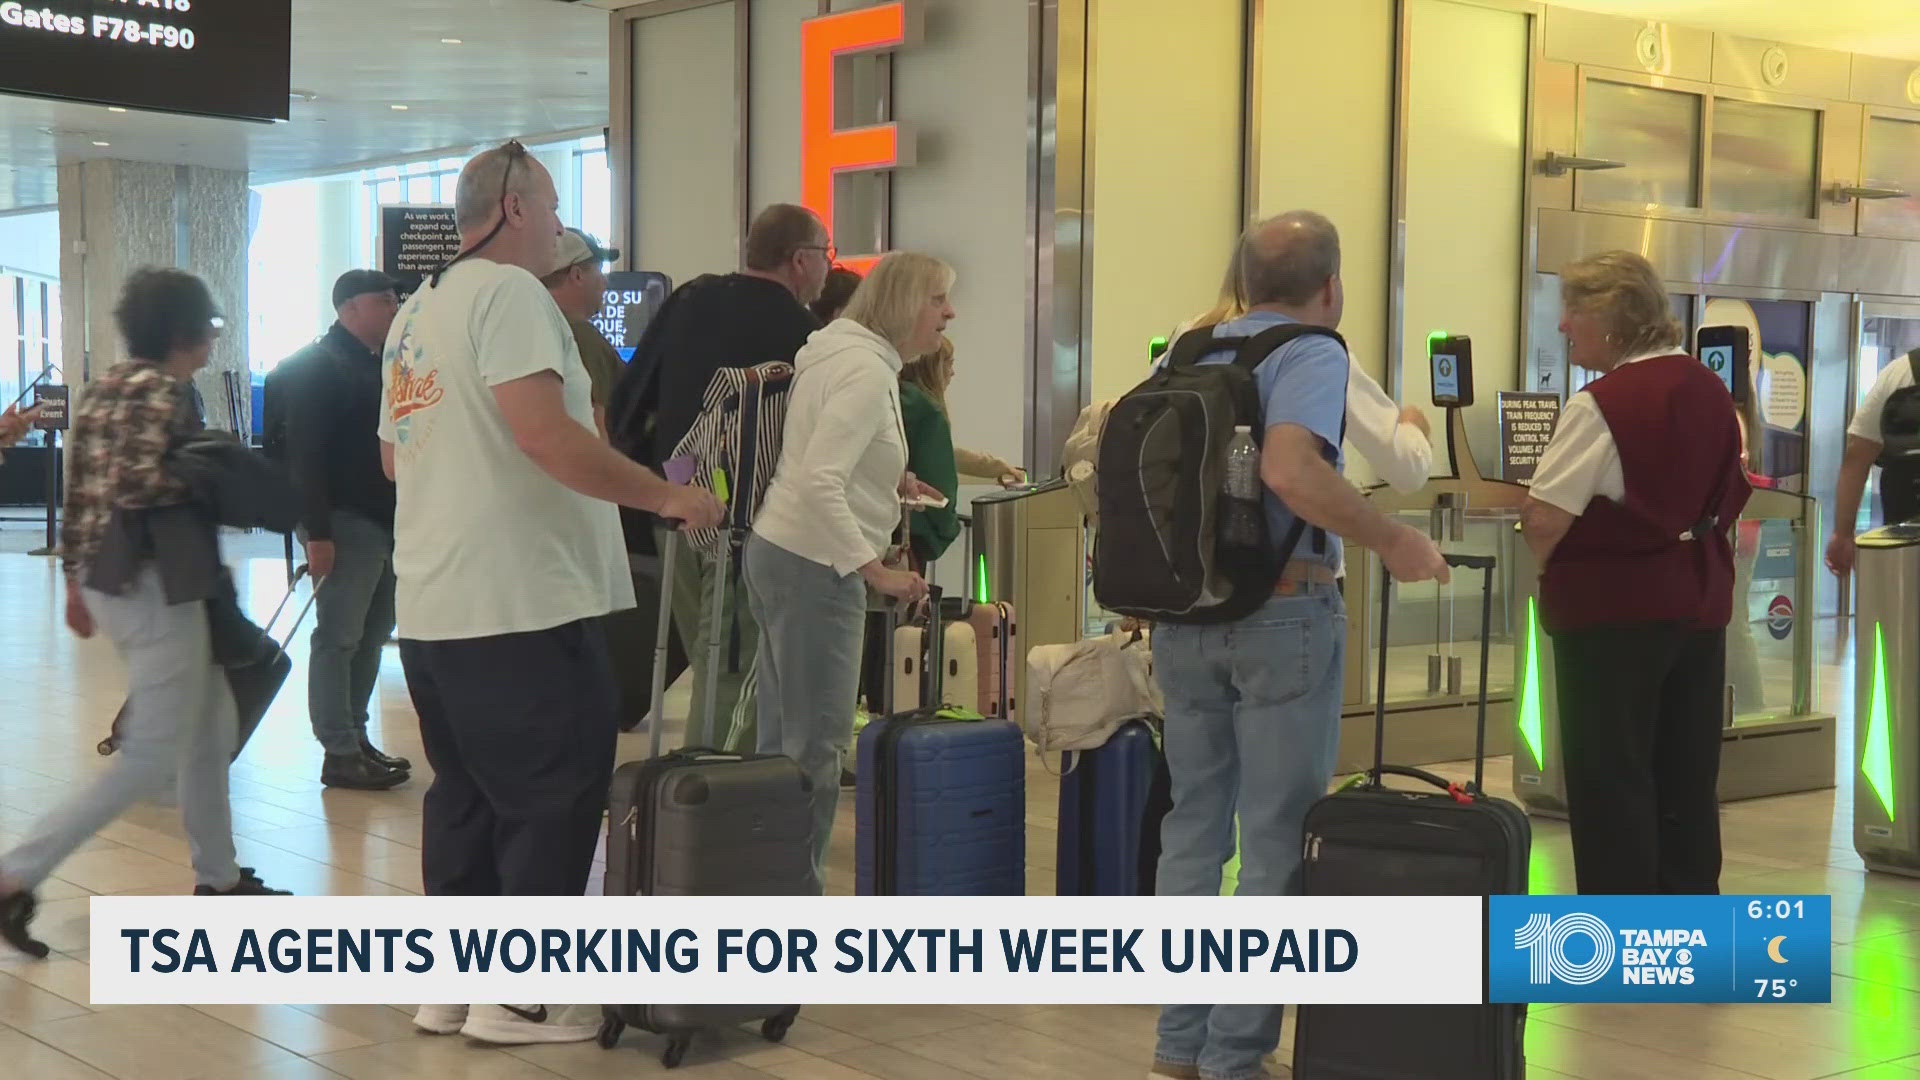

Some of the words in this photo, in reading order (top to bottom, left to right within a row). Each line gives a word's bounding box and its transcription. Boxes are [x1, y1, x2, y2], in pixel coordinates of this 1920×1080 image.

[0, 1, 86, 35] Gates
[92, 14, 195, 50] F78-F90
[801, 2, 904, 281] E
[404, 212, 414, 220] As
[429, 212, 449, 220] work
[410, 222, 439, 231] expand
[400, 232, 443, 241] checkpoint
[402, 243, 445, 252] passengers
[398, 254, 440, 262] experience
[397, 262, 416, 270] than
[623, 291, 642, 304] SU
[606, 305, 625, 318] DE
[591, 319, 627, 334] QUE,
[1502, 400, 1522, 409] DURING
[1523, 400, 1537, 409] PEAK
[1538, 400, 1558, 409] TRAVEL
[1506, 411, 1523, 420] TRAIN
[1524, 411, 1555, 421] FREQUENCY
[1511, 422, 1517, 431] IS
[1518, 422, 1542, 431] REDUCED
[1543, 422, 1551, 431] TO
[1513, 433, 1538, 442] CONTROL
[1539, 433, 1550, 442] THE
[1508, 444, 1534, 454] VOLUMES
[1535, 445, 1542, 453] AT
[1509, 456, 1535, 465] SECURITY
